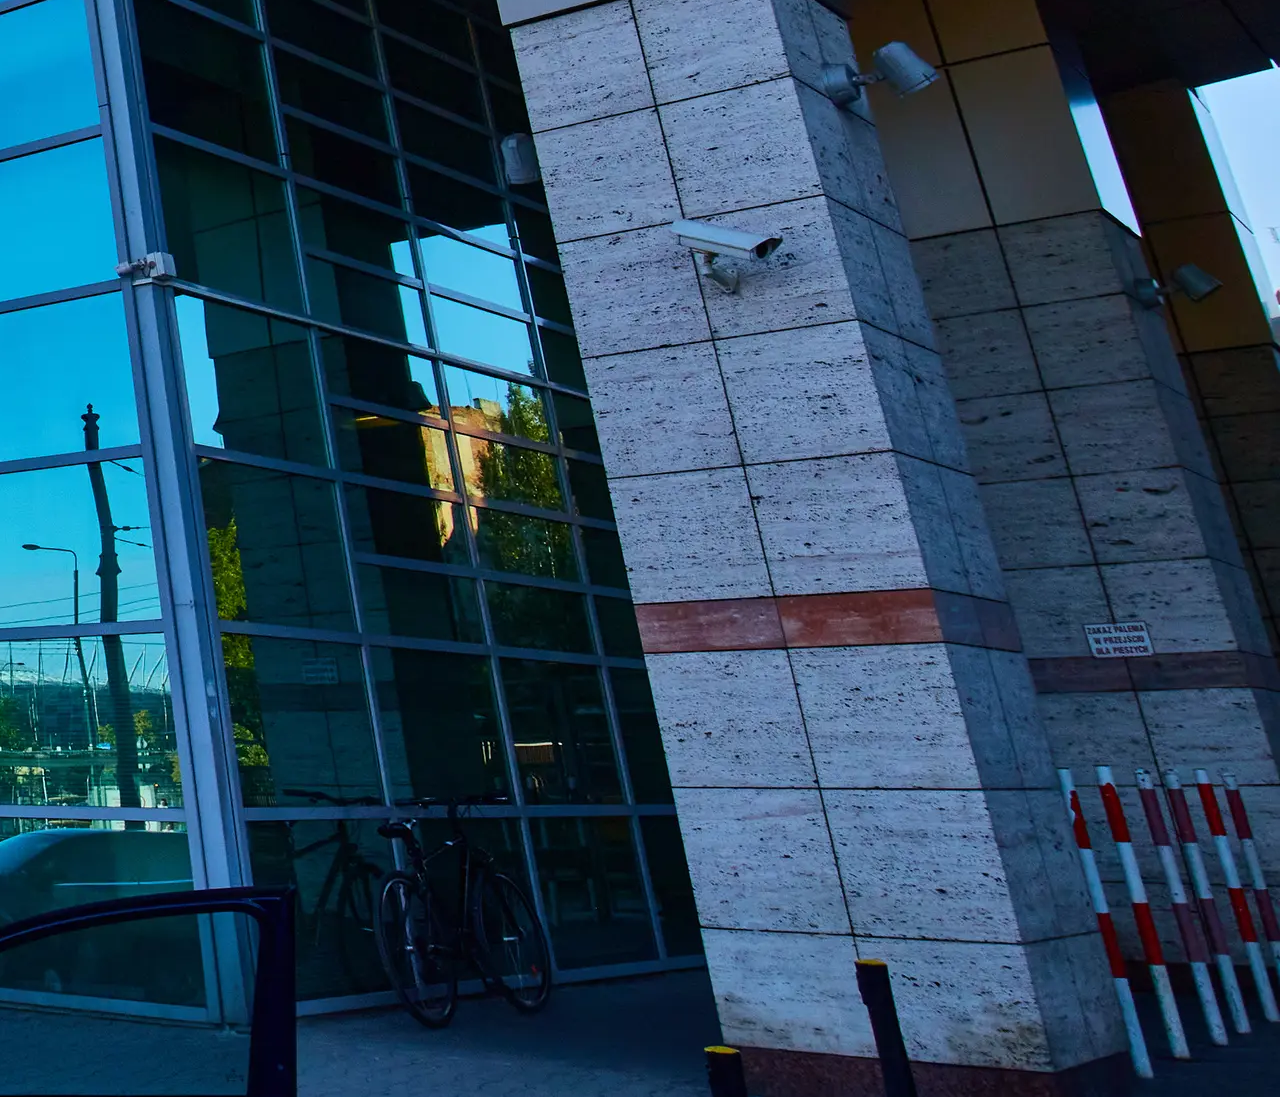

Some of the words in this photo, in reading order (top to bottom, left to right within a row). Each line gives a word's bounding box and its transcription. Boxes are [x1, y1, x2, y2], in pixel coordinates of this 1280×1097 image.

[1087, 626, 1113, 635] ZAKAZ
[1114, 624, 1145, 633] PALENIA
[1096, 647, 1111, 655] DLA
[1112, 645, 1148, 654] PIESZYCH
